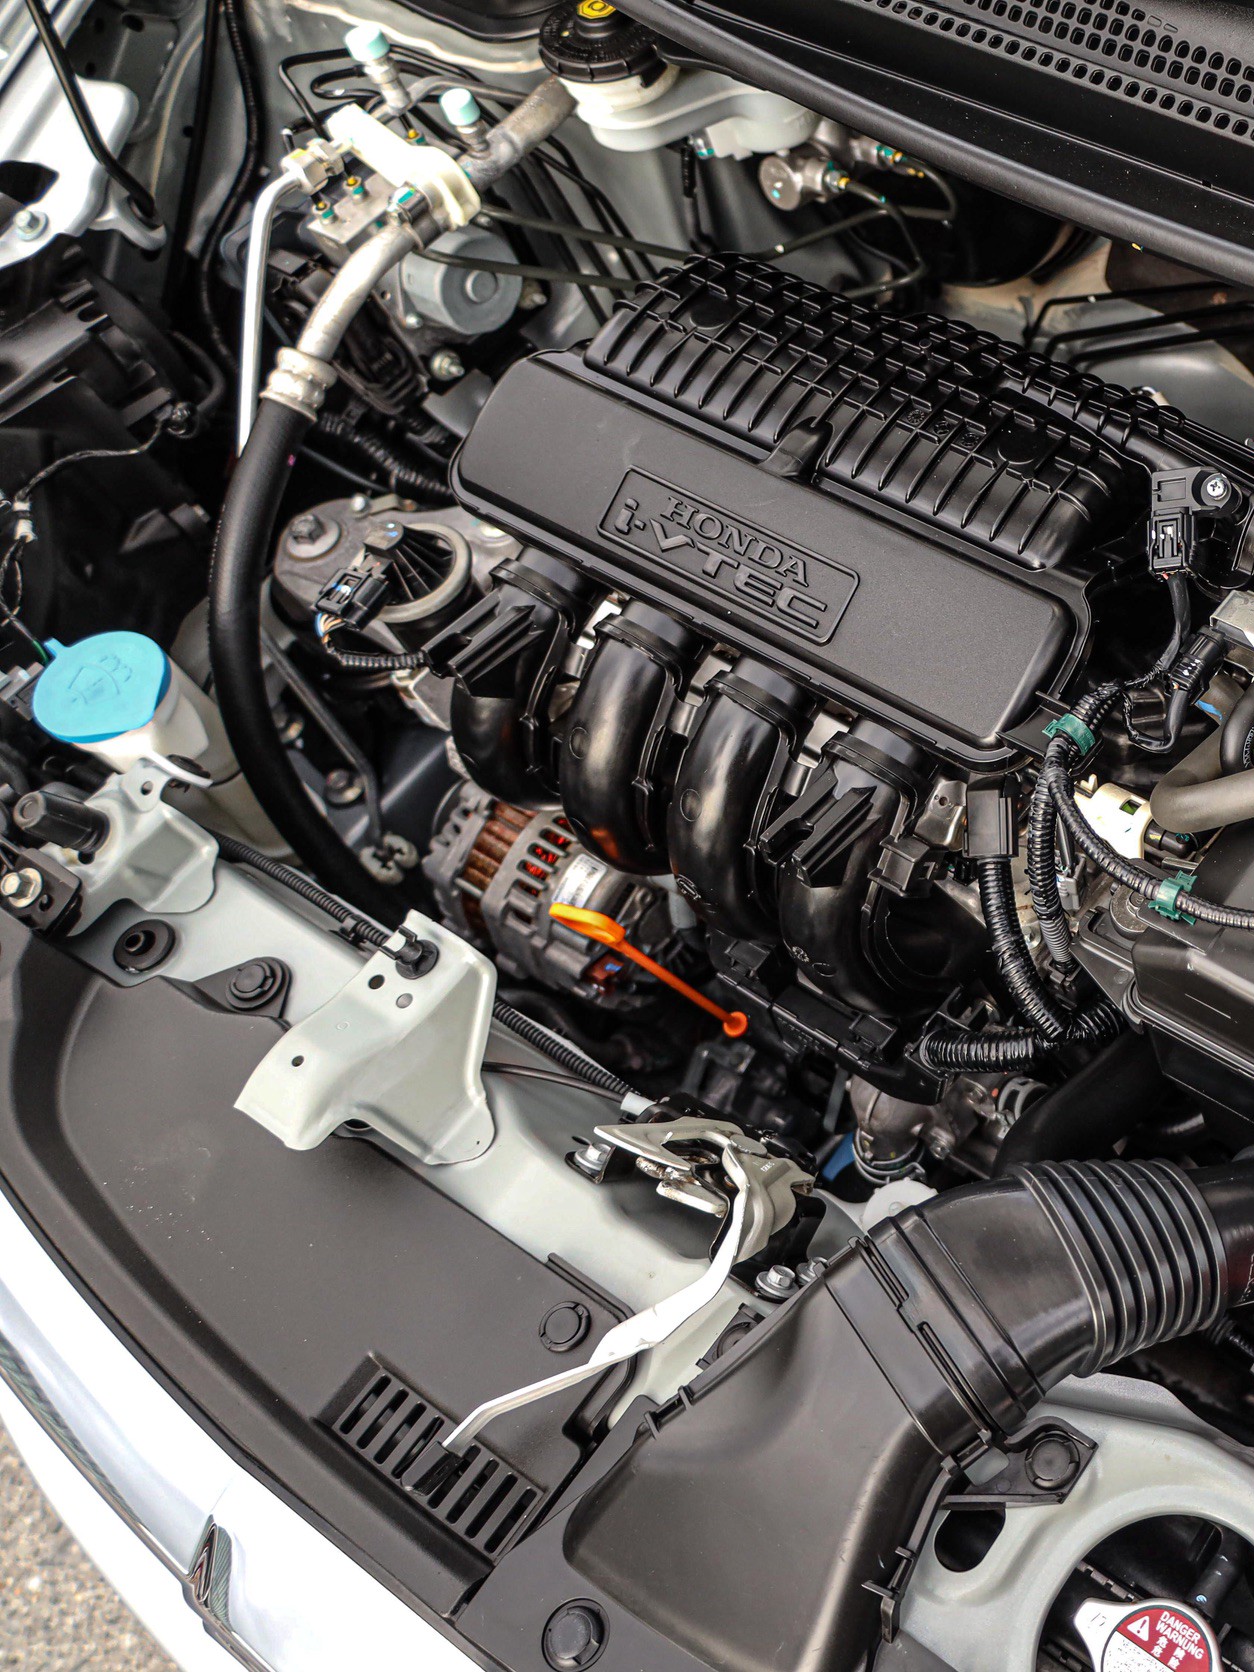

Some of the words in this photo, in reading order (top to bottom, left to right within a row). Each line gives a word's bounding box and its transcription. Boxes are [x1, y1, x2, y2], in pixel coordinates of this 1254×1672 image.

[614, 497, 827, 629] i-VTEC
[660, 496, 809, 587] HONDA
[1155, 1621, 1204, 1660] WARNUNG
[1160, 1611, 1201, 1644] DANGER
